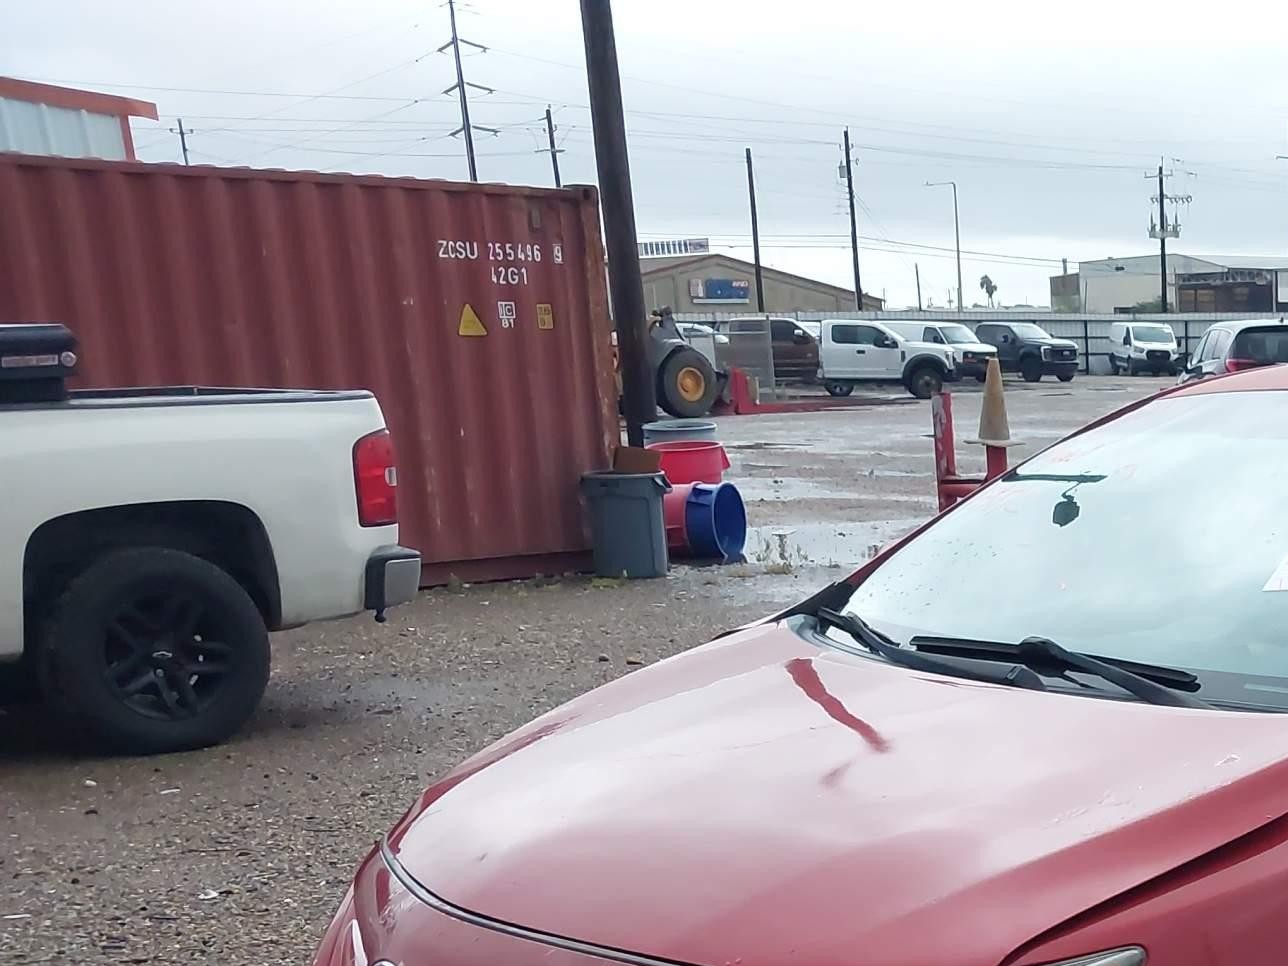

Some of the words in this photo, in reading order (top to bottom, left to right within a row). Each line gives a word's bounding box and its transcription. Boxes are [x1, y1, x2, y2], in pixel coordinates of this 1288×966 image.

[438, 241, 478, 259] ZCSU
[488, 243, 541, 262] 255496
[491, 267, 528, 285] 42G1
